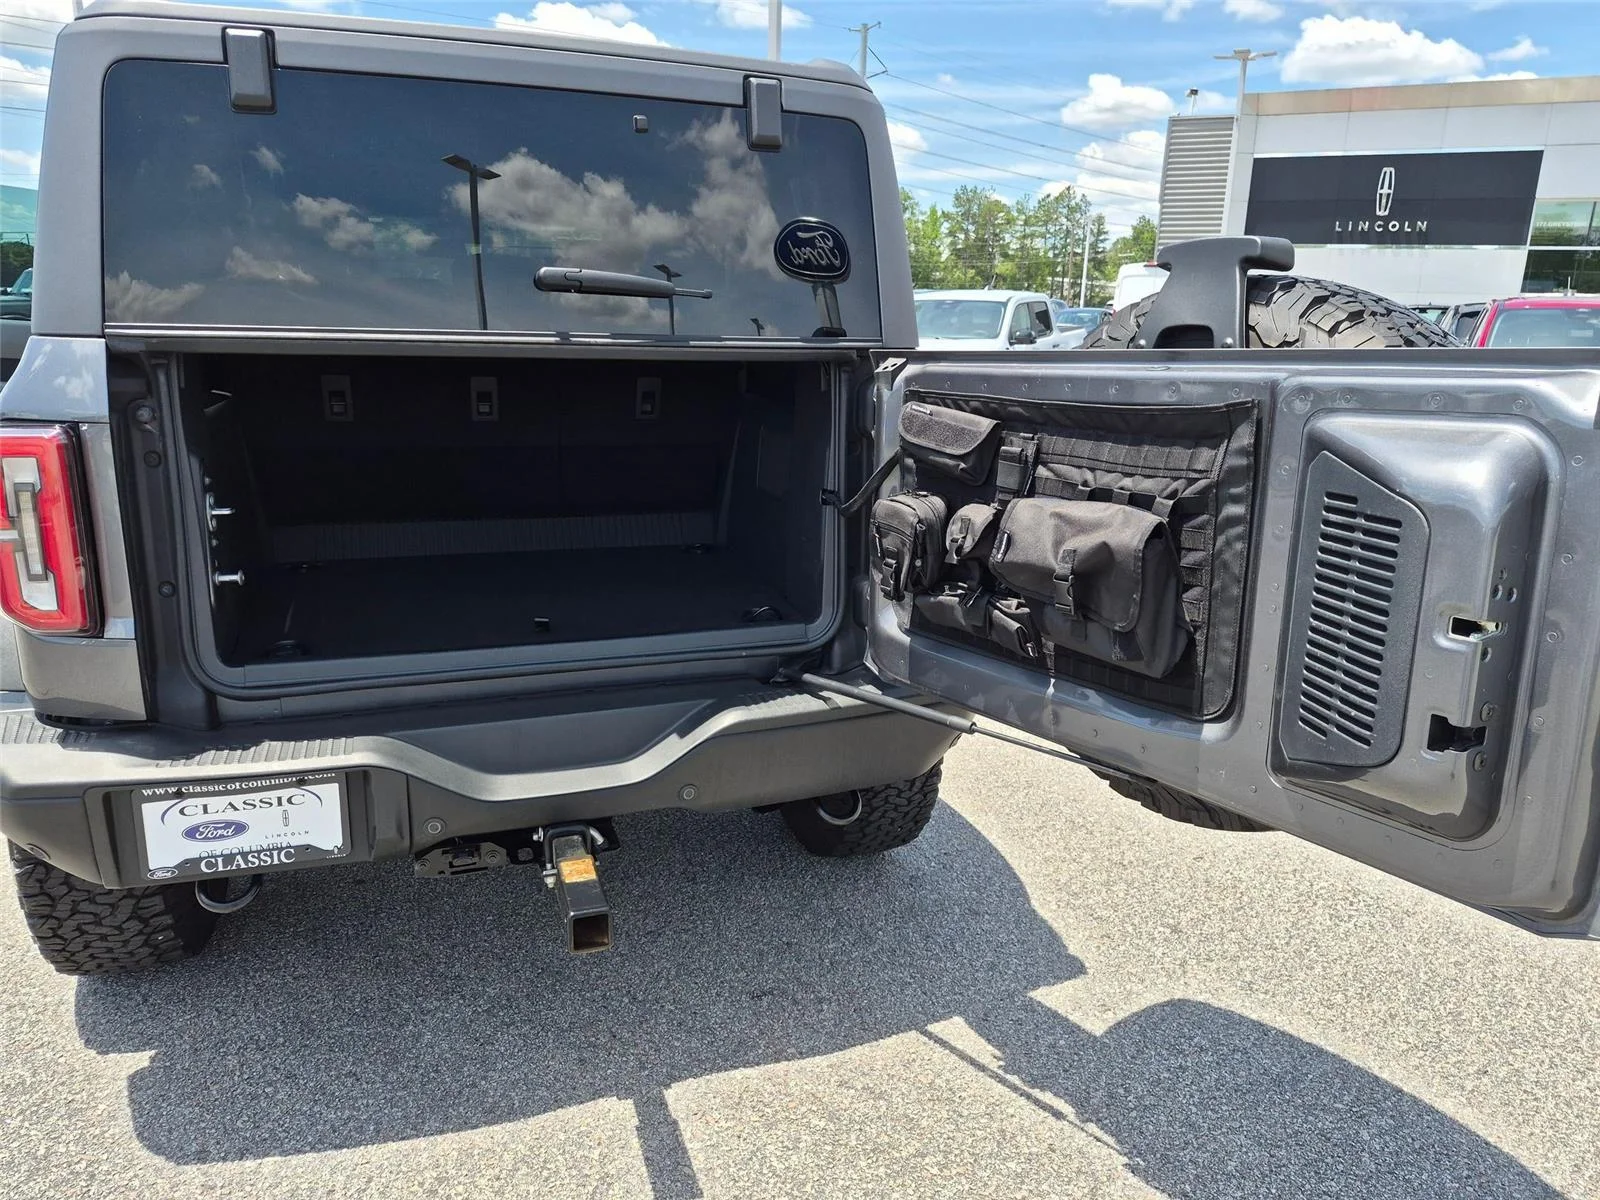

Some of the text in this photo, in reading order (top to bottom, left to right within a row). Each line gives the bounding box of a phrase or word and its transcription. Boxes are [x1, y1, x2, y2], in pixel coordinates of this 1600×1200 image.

[1335, 220, 1428, 232] LINCOLN
[141, 772, 336, 797] wwwclassicofcolumbi.com
[178, 793, 305, 817] CLASSIC
[195, 823, 236, 839] Ford
[264, 829, 310, 839] LINCOLN
[200, 848, 296, 873] CLASSIC
